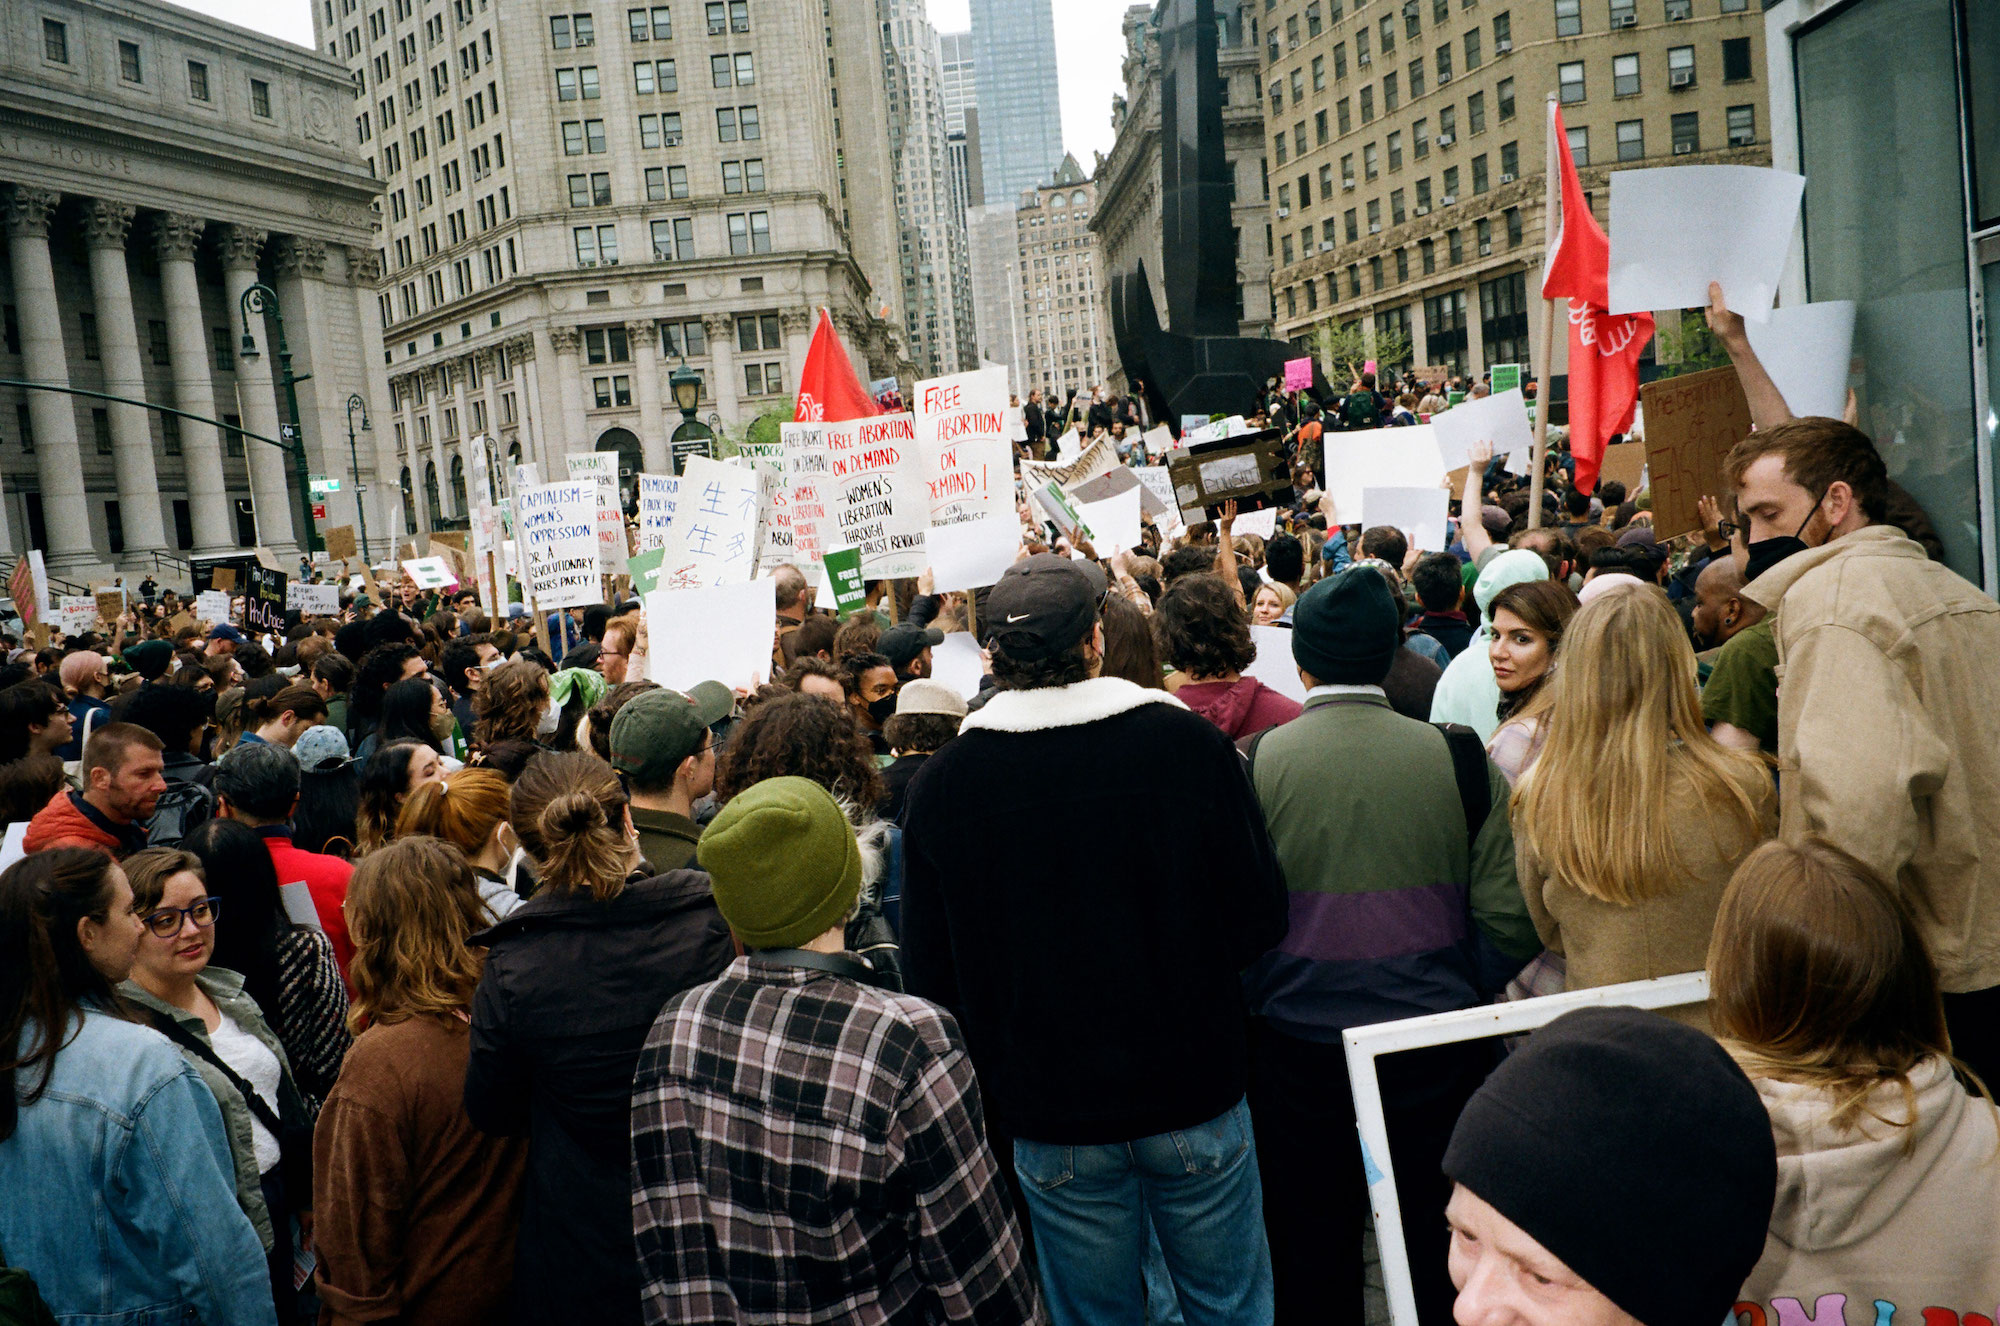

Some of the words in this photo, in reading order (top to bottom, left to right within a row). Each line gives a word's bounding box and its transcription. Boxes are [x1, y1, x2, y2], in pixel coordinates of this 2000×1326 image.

[49, 143, 131, 175] HOUSE
[924, 385, 961, 414] FREE
[827, 430, 854, 451] FREE
[859, 419, 914, 445] ABORTION
[937, 411, 1003, 441] ABORTION
[784, 432, 800, 448] FREE
[833, 459, 847, 477] ON
[850, 447, 900, 472] DEMAND
[941, 448, 956, 471] ON
[520, 487, 580, 510] CAPITALISM
[643, 499, 661, 511] FAUX
[791, 504, 825, 520] LIBERATION
[837, 499, 893, 528] LIBERATION
[530, 524, 591, 545] OPPRESSION
[842, 521, 884, 544] THROUGH
[547, 545, 554, 559] A
[837, 568, 859, 581] FREE
[848, 578, 860, 590] ON
